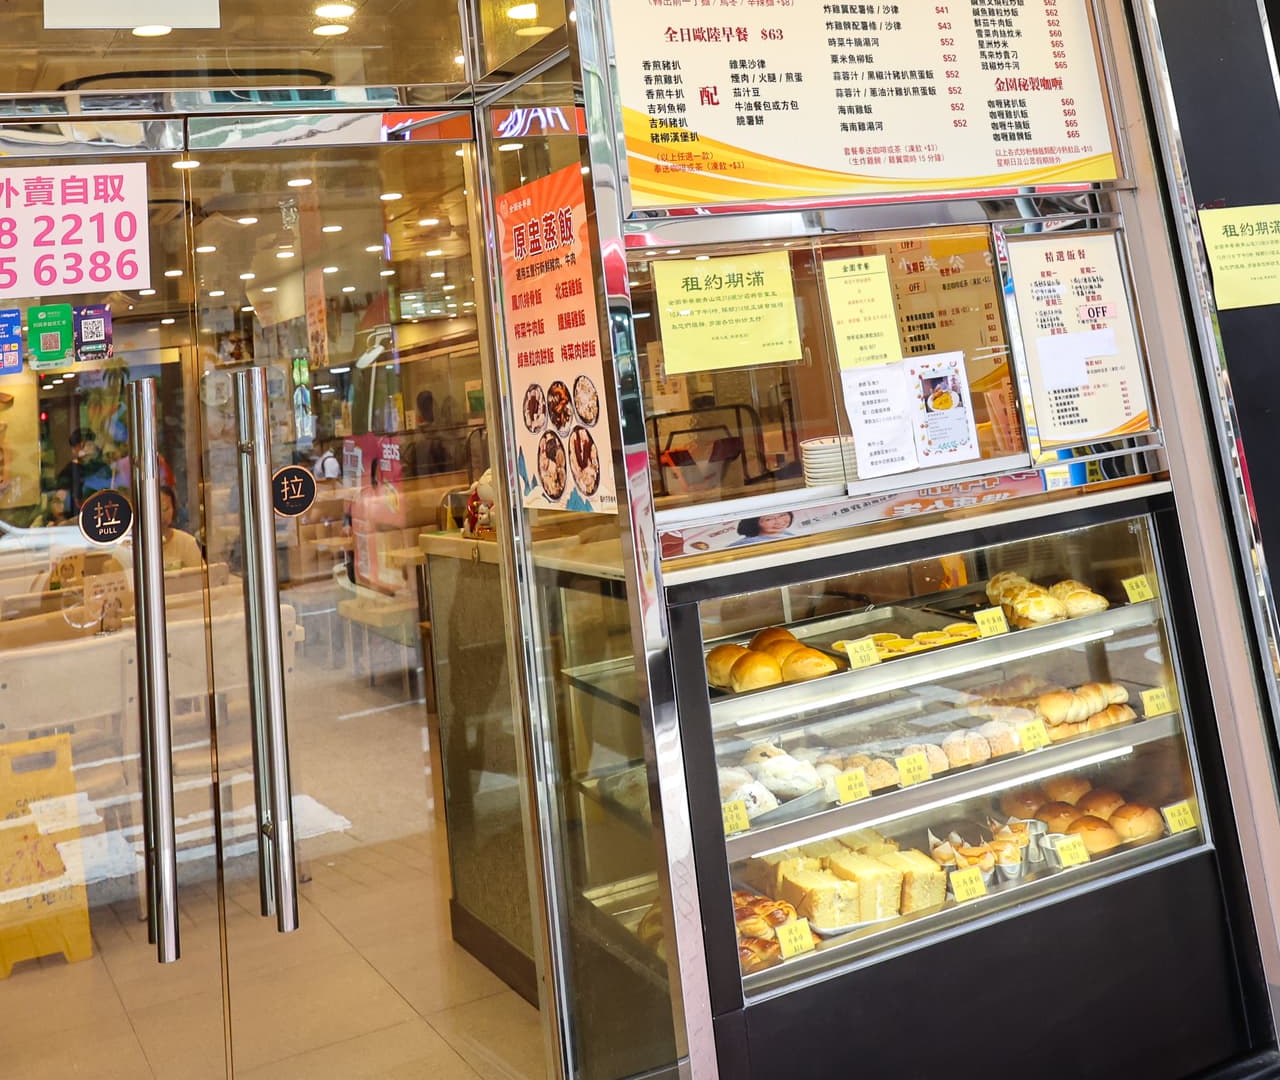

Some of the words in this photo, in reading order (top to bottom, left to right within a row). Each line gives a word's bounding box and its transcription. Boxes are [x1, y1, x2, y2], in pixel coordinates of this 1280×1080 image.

[761, 28, 784, 41] $63
[699, 86, 720, 106] 配
[1061, 98, 1074, 106] $60
[951, 103, 965, 111] $52
[953, 119, 967, 128] $52
[1065, 120, 1078, 128] $65
[33, 211, 137, 247] 2210
[513, 207, 574, 261] 原盅蒸飯
[33, 249, 139, 286] 6386
[681, 271, 765, 292] 租約期滿
[908, 282, 921, 292] OFF
[1088, 306, 1108, 318] OFF
[281, 475, 305, 501] 拉
[94, 500, 120, 528] 拉
